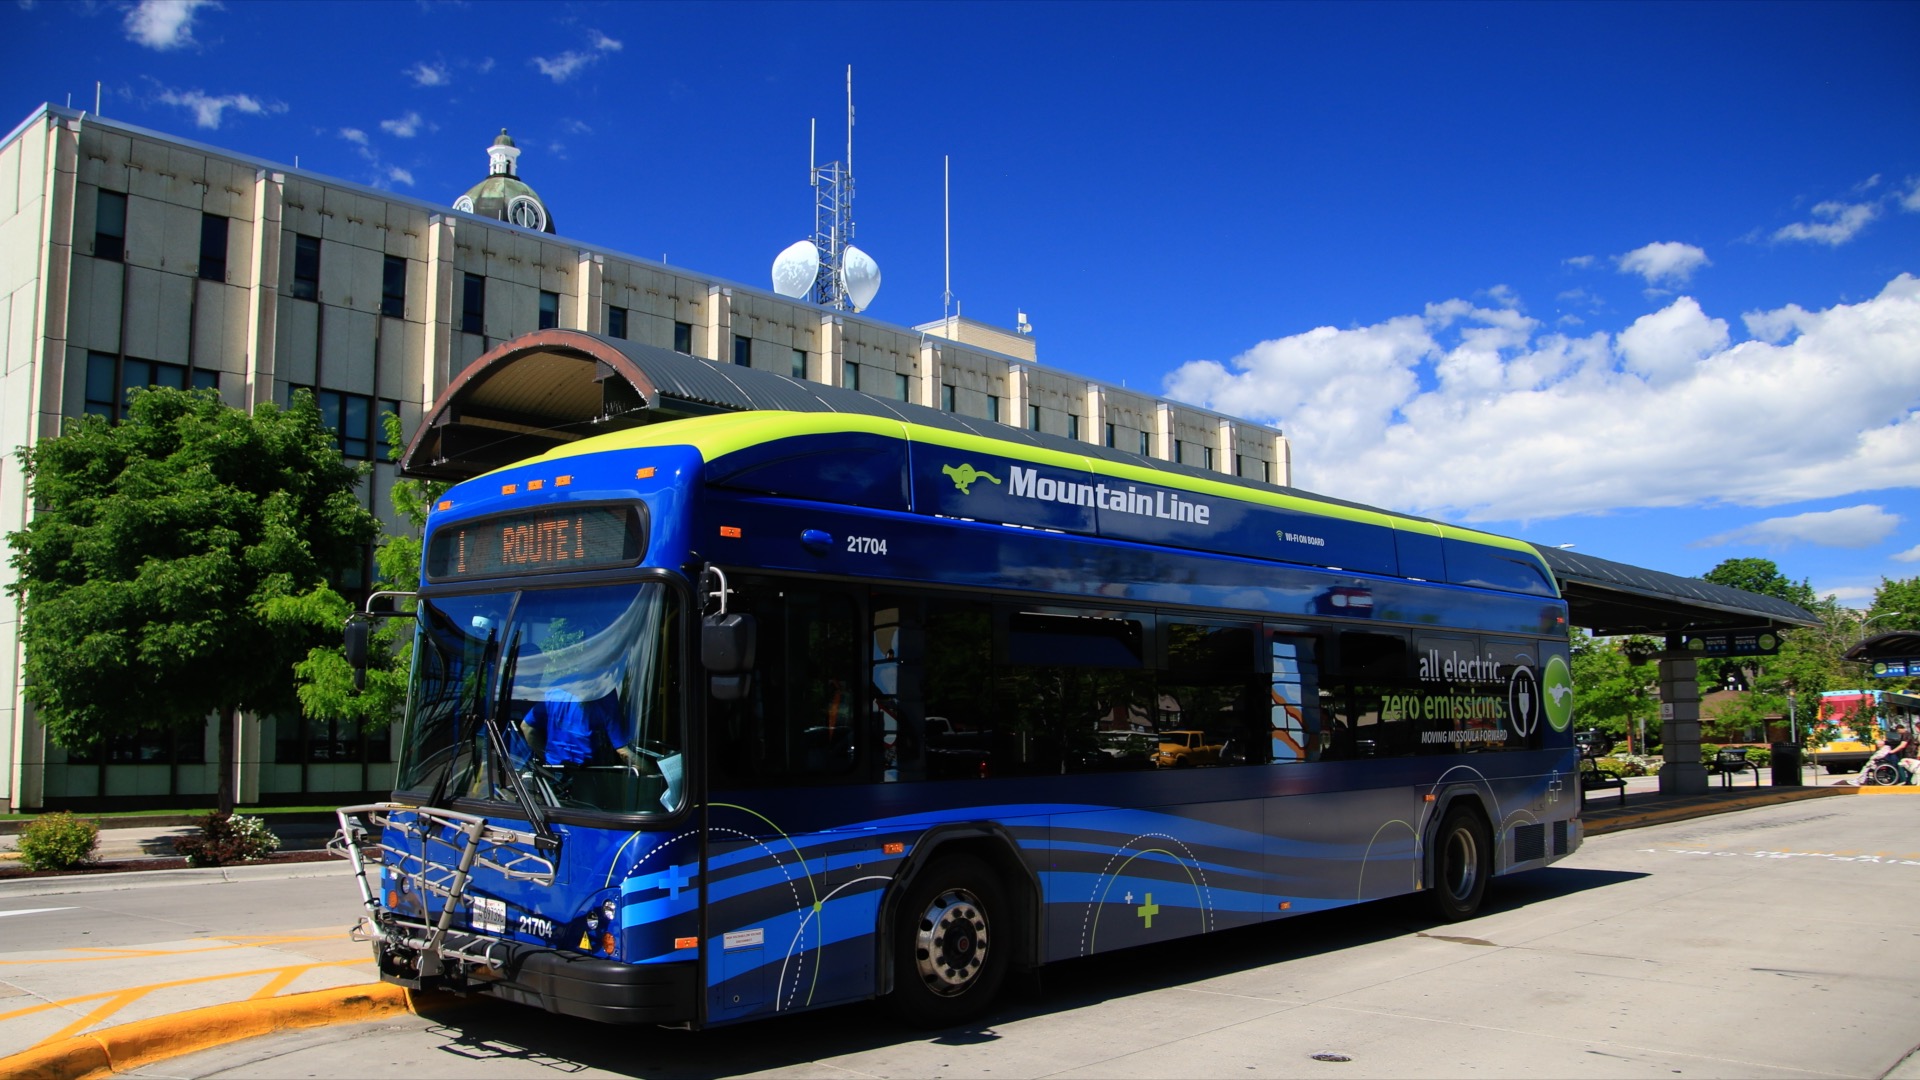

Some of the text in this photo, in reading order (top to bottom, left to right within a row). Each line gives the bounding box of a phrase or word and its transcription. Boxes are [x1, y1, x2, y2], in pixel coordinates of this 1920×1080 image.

[502, 519, 569, 565] ROUTE
[574, 517, 584, 559] 1
[847, 535, 888, 556] 21704
[1307, 536, 1325, 547] BOARD
[1420, 649, 1506, 684] all electric.
[1381, 686, 1507, 720] zero emissions.
[1421, 729, 1508, 744] MOVING MISSOULA FORWARD
[519, 915, 553, 938] 21704
